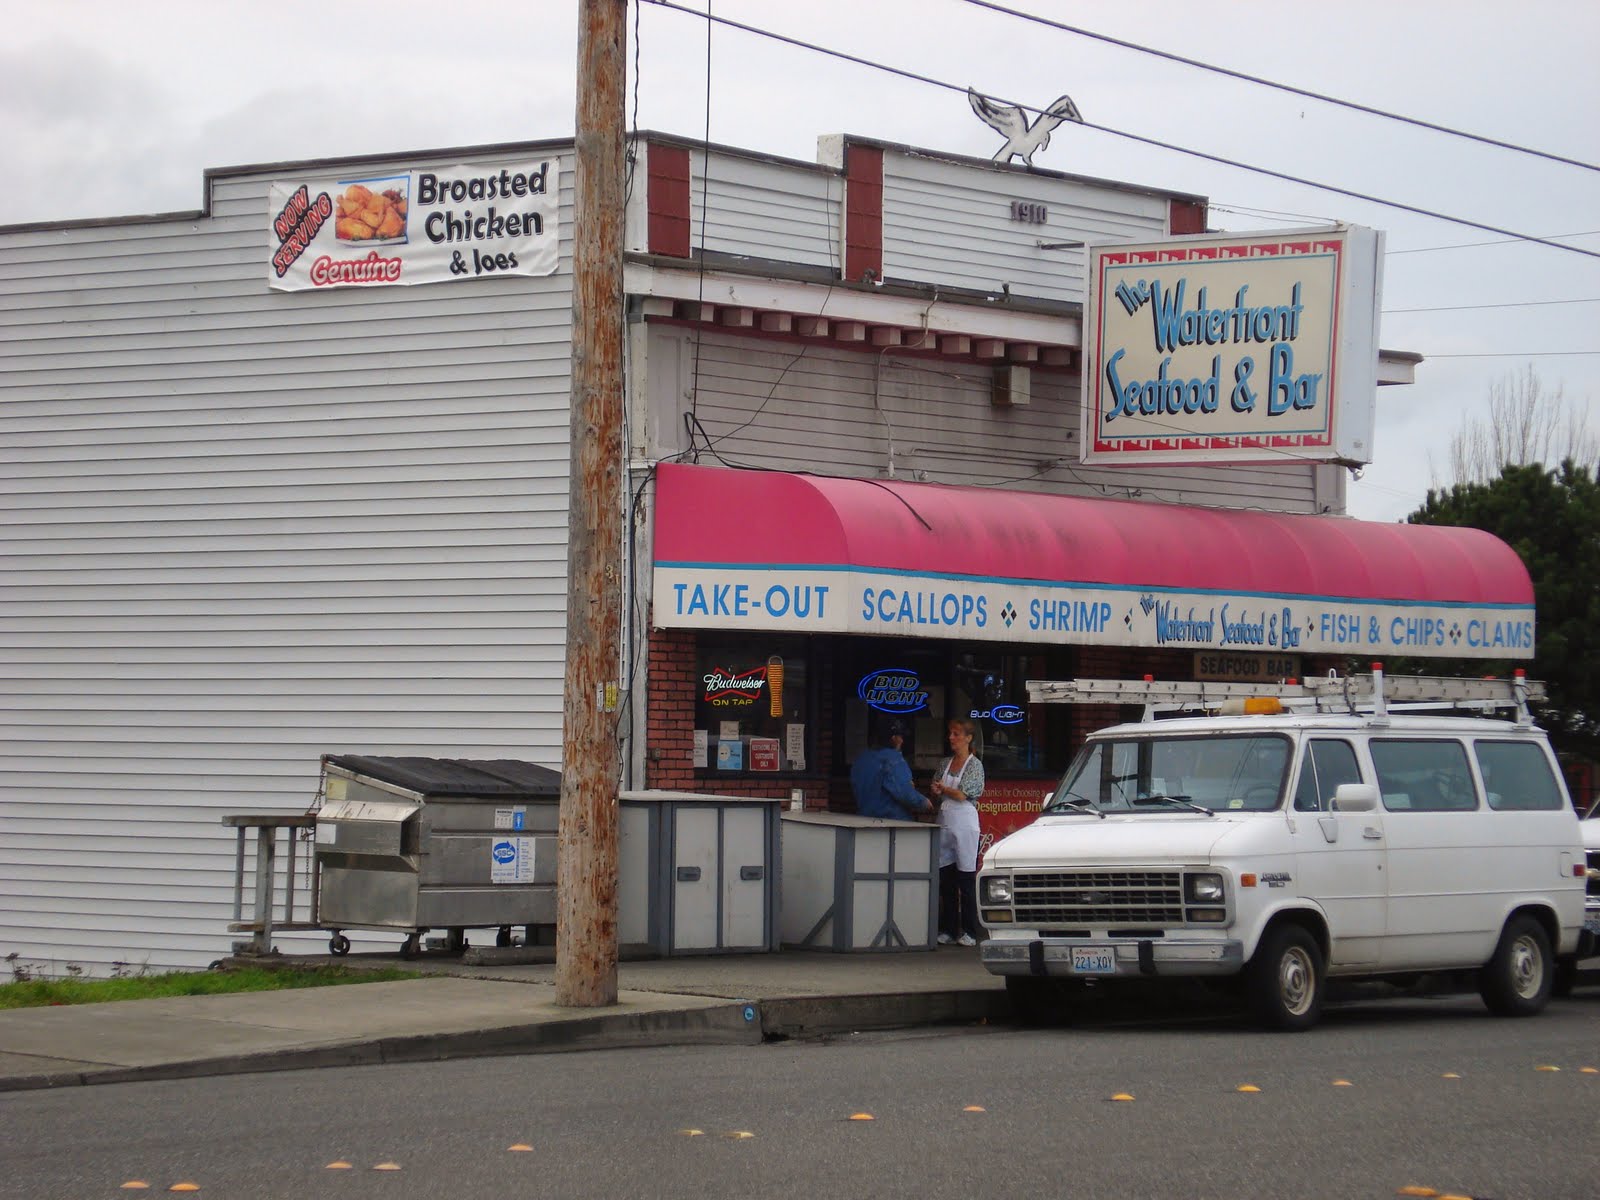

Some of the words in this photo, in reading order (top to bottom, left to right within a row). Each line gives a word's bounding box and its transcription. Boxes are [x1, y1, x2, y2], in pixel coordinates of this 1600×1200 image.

[417, 162, 549, 205] Broasted
[274, 184, 308, 241] NOW
[424, 207, 544, 244] Chicken
[1011, 201, 1048, 224] 1910
[272, 191, 332, 278] SERVING
[311, 251, 402, 286] Genuine
[450, 250, 468, 275] &
[472, 249, 519, 275] Joes
[1115, 279, 1150, 317] The
[1150, 278, 1304, 354] Waterfront
[1105, 347, 1221, 423] Seafood
[1231, 356, 1258, 413] &
[1267, 342, 1323, 417] Bar
[673, 583, 829, 618] TAKE-OUT
[862, 587, 987, 628] SCALLOPS
[1029, 599, 1112, 634] SHRIMP
[1155, 600, 1216, 645] Waterfront
[1219, 602, 1266, 647] Seafood
[1268, 613, 1278, 646] &
[1281, 607, 1302, 650] Bar
[1320, 613, 1360, 644] FISH
[1368, 616, 1381, 644] &
[1391, 617, 1445, 647] CHIPS
[1467, 619, 1532, 649] CLAMS
[703, 674, 766, 691] Budweiser
[873, 675, 920, 691] BUD
[1200, 656, 1260, 675] SEAFOOD
[1267, 659, 1294, 677] BAR
[732, 698, 753, 706] TAP
[866, 689, 929, 706] LIGHT
[970, 709, 991, 719] BUD
[976, 800, 1022, 816] Designated
[1025, 801, 1044, 812] Driv
[983, 788, 1002, 798] hanks
[1003, 788, 1012, 798] for
[1012, 788, 1041, 799] Choosing
